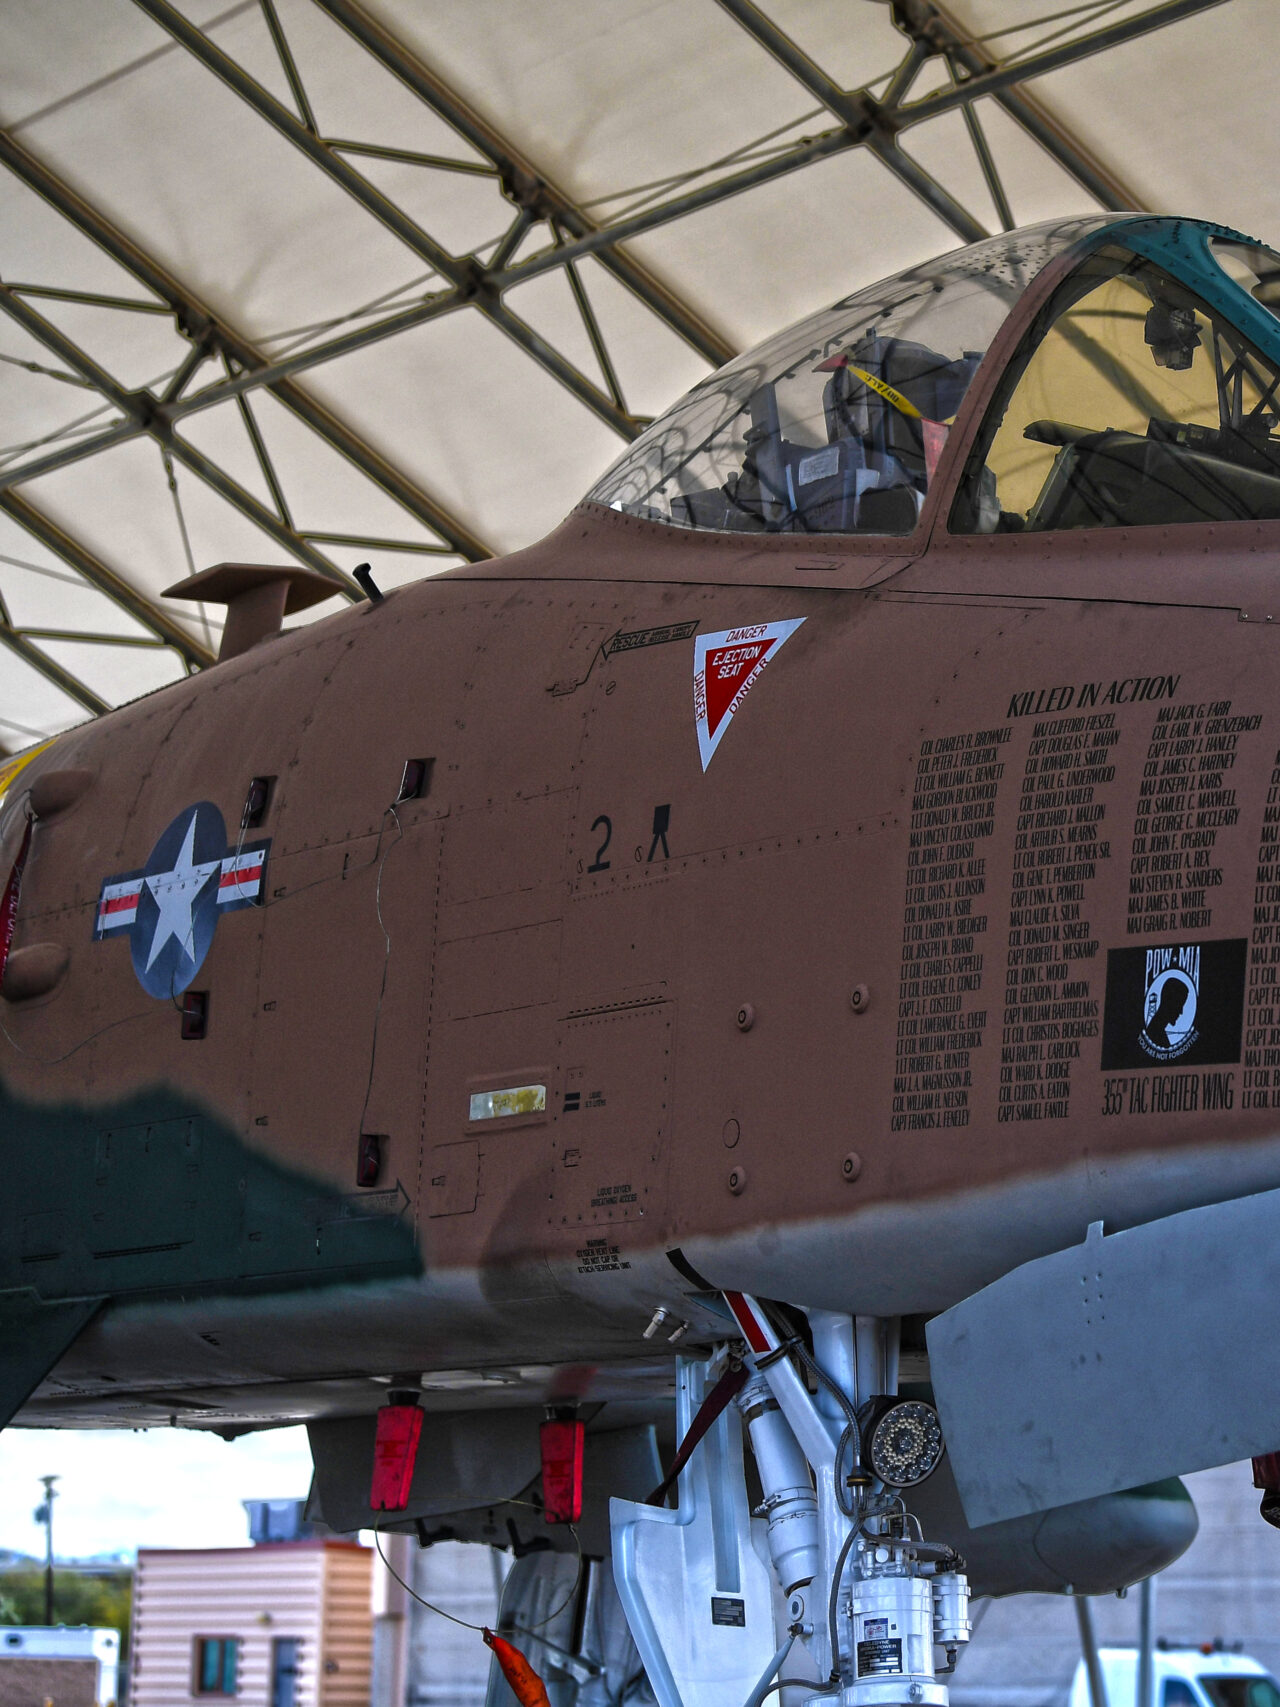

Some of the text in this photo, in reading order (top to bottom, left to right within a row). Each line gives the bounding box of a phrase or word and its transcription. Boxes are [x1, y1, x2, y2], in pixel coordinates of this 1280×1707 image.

[610, 632, 650, 650] RESCUE
[726, 625, 768, 642] DANGER
[713, 645, 761, 666] EJECTION
[718, 664, 744, 679] SEAT
[695, 670, 706, 721] DANGER
[729, 658, 770, 714] DANGER
[1007, 674, 1180, 718] KILLED IN ACTION
[1025, 749, 1109, 774] COL HOWARD H. SMITH
[1134, 808, 1240, 835] COL GEORGE C. MCCLEARY
[587, 815, 611, 873] 2
[1131, 850, 1211, 874] CAPT ROBERT A. REX
[1130, 868, 1223, 894] MAJ STEVEN R. SANDERS
[1128, 890, 1206, 914] MAJ JAMES B. WHITE
[1145, 946, 1200, 997] POW MIA
[1250, 968, 1259, 985] LT
[1262, 967, 1277, 984] COL
[1004, 1000, 1098, 1024] CAPT WILLIAM BARTHELMAS
[1138, 1031, 1199, 1060] YOU ARE NOT FORGOTTEN
[1246, 1029, 1267, 1046] CAPT
[1245, 1050, 1261, 1067] MAJ
[999, 1081, 1070, 1103] COL CURTIS A. EATON
[1129, 1076, 1149, 1114] TAC
[1151, 1074, 1199, 1113] FIGHTER
[1202, 1072, 1235, 1110] WING
[1242, 1091, 1252, 1109] LT
[1254, 1090, 1269, 1108] COL
[891, 1109, 970, 1131] CAPT FRANCIS J. FENELEY
